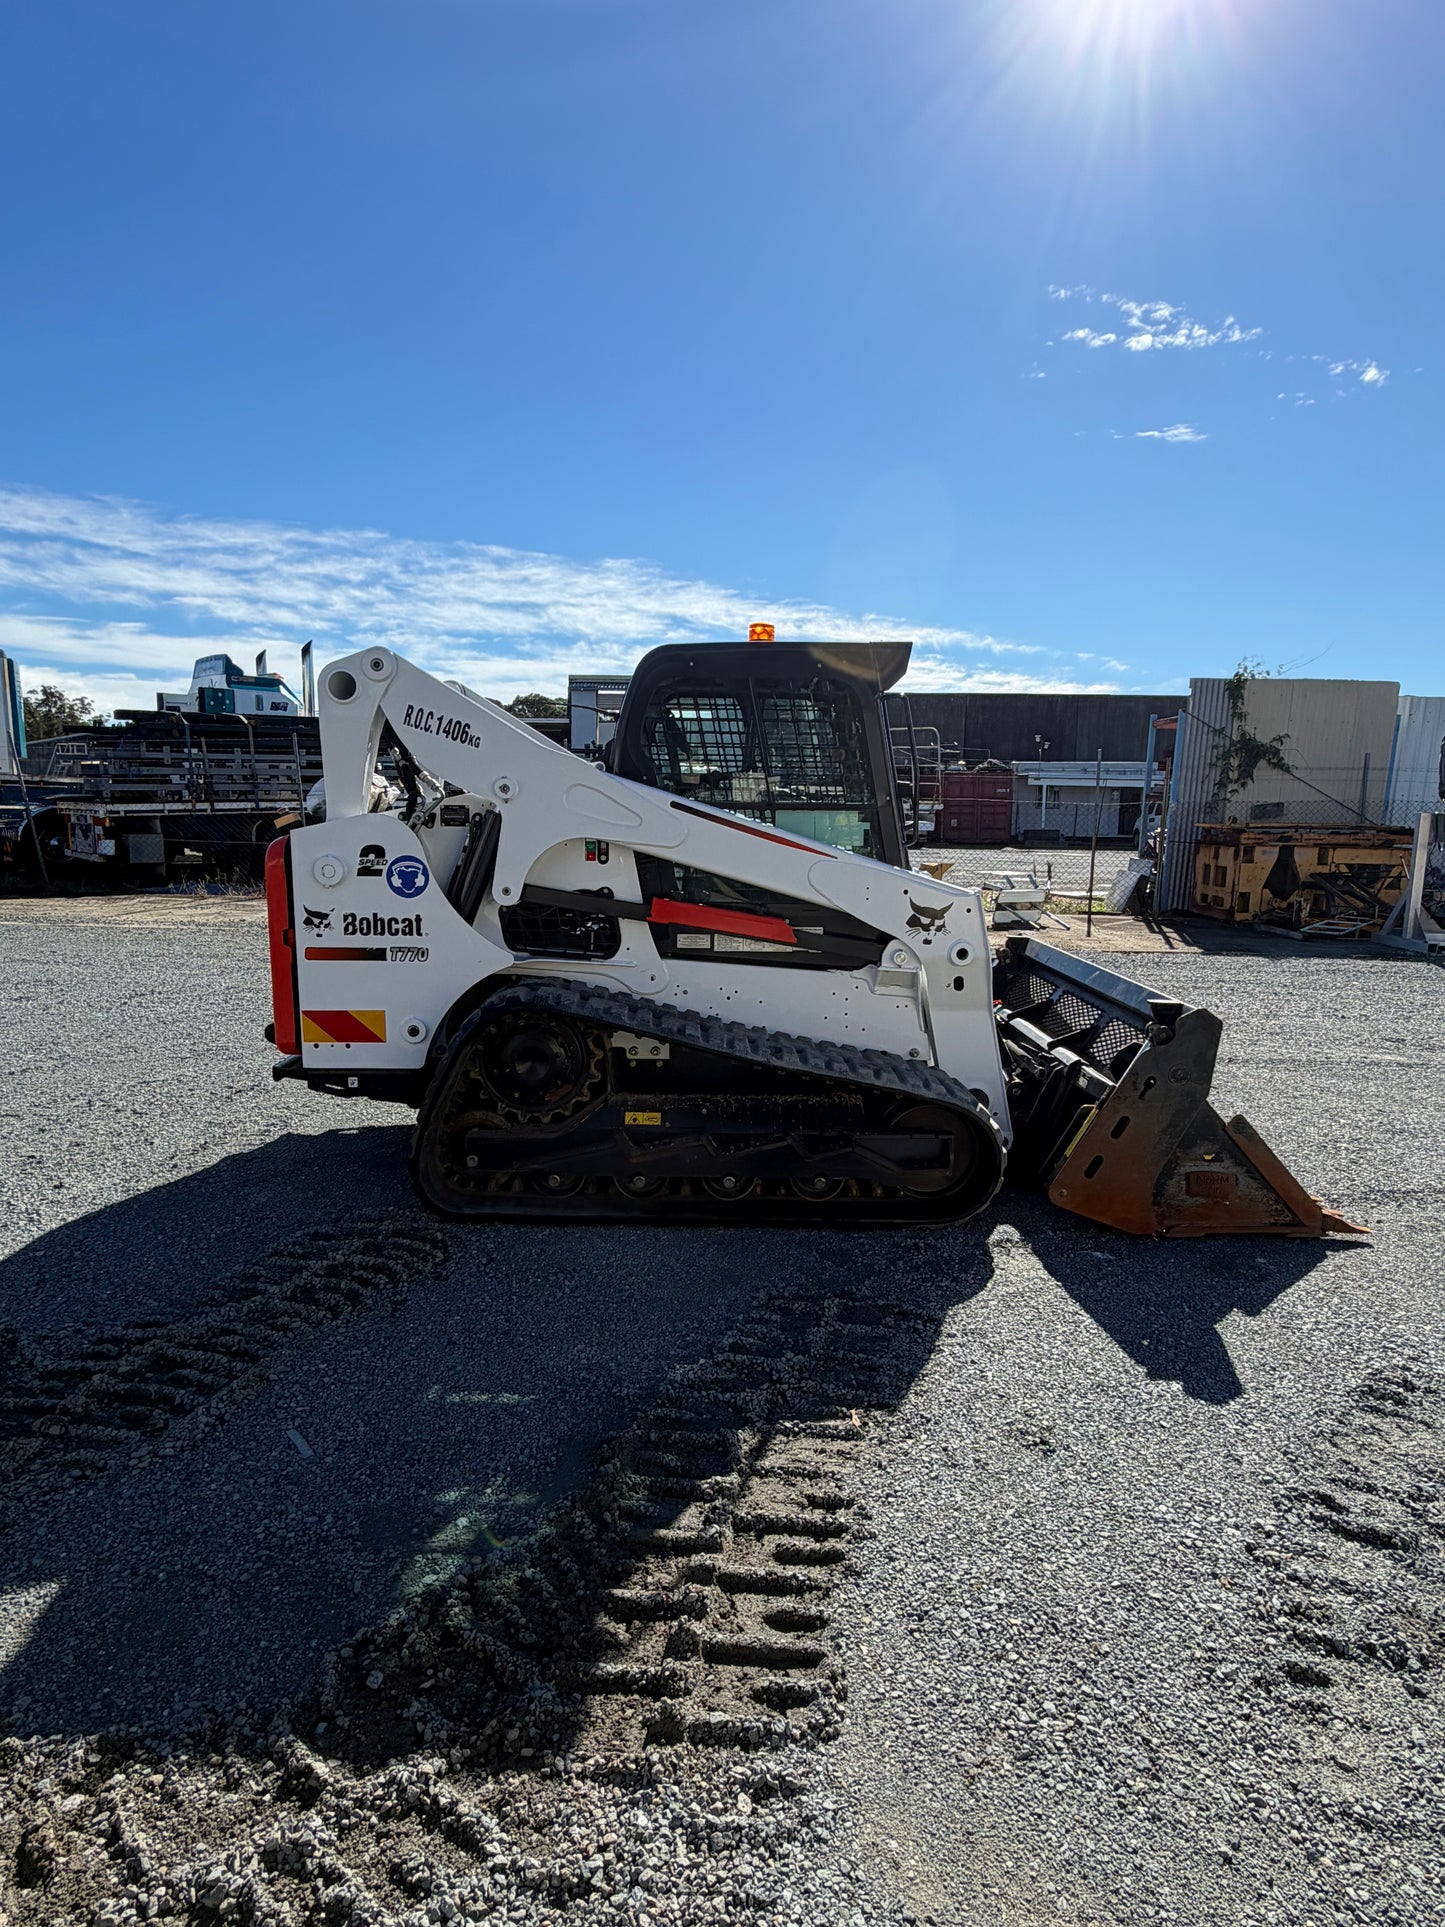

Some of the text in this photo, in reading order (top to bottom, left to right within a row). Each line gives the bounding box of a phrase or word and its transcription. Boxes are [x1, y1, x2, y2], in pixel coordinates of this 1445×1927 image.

[356, 844, 386, 877] 2
[343, 912, 423, 936] Bobcat
[390, 947, 429, 962] T770
